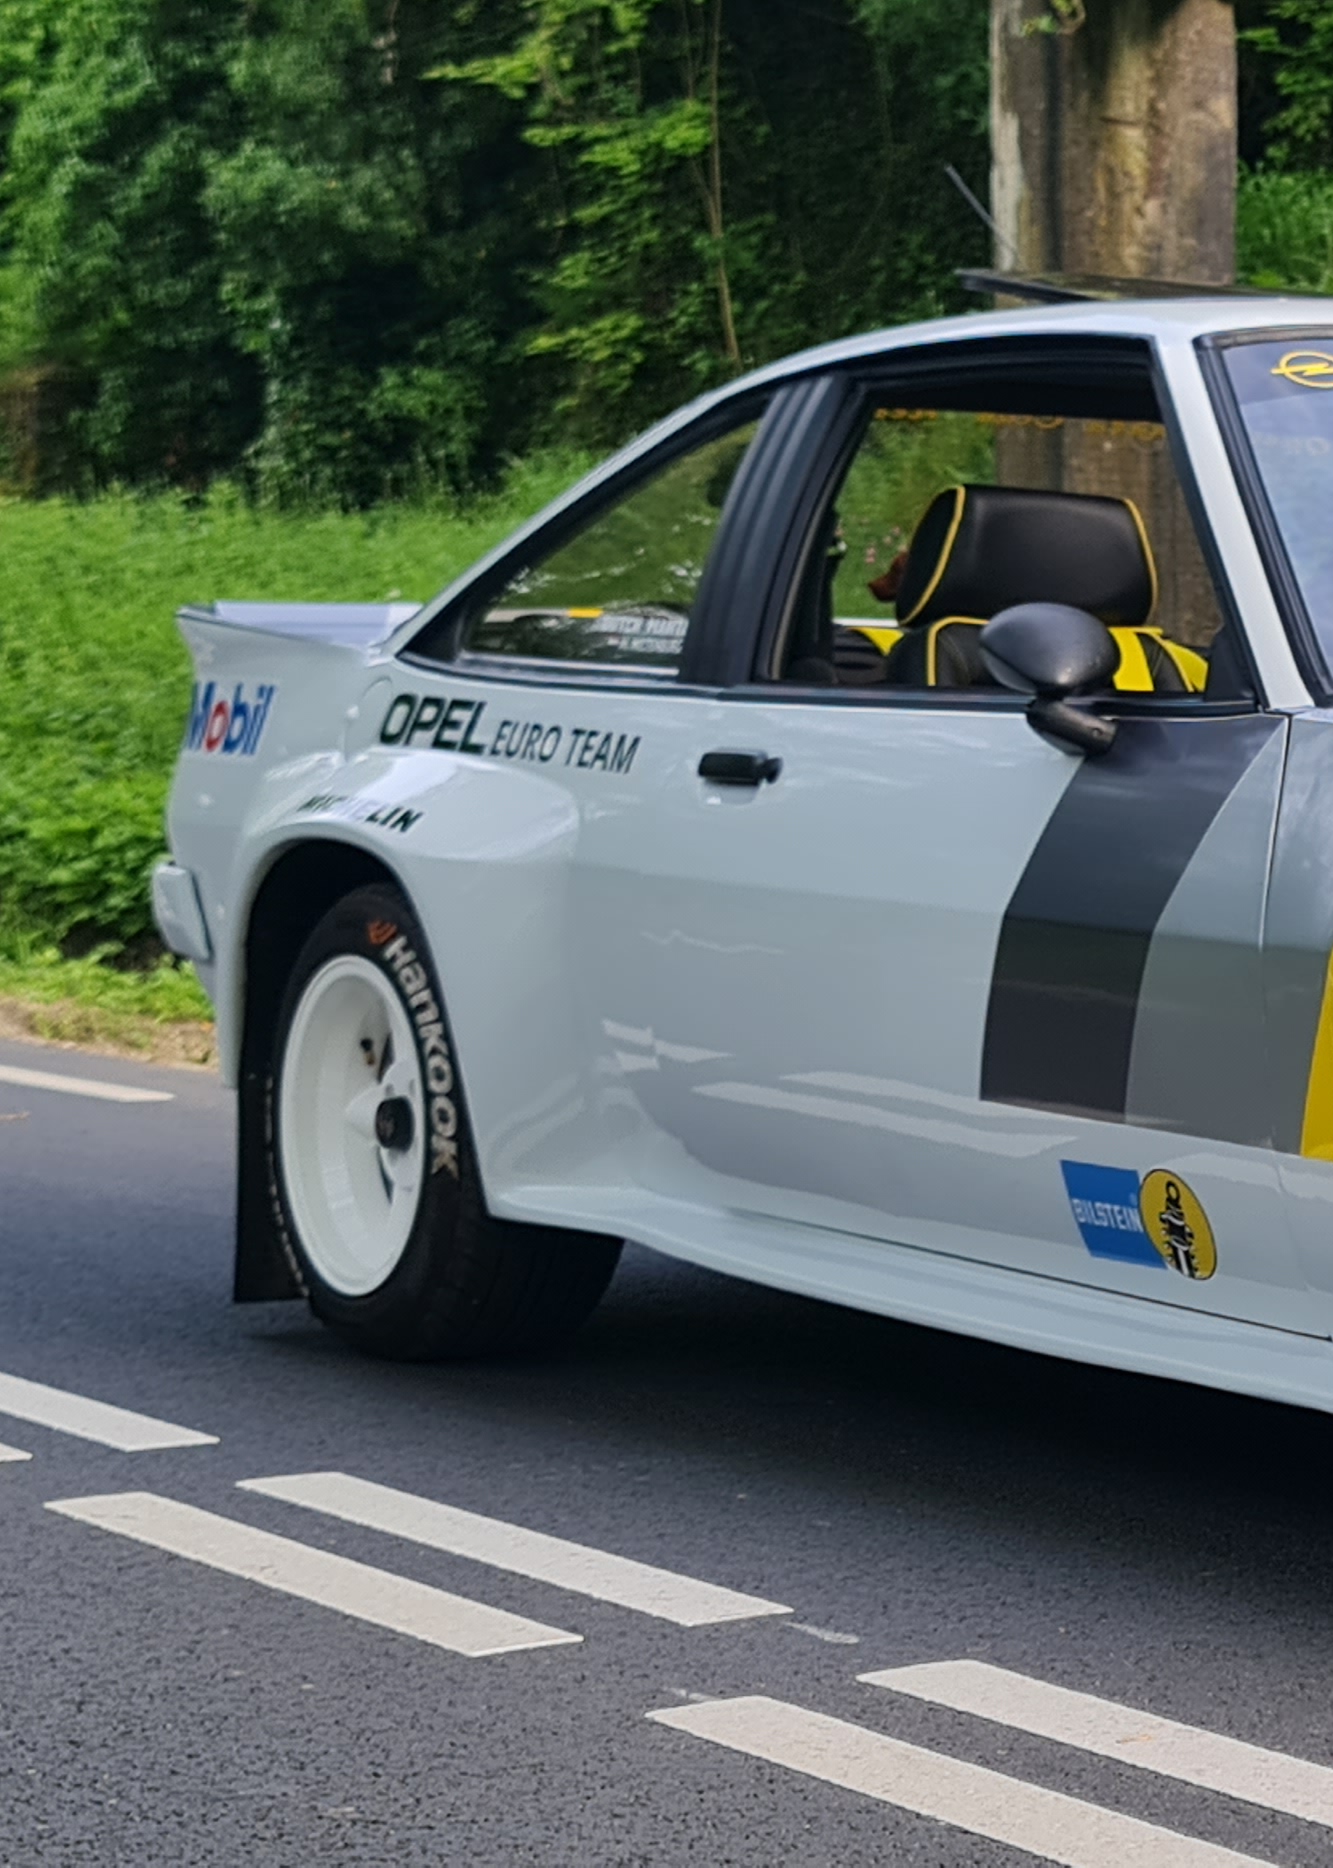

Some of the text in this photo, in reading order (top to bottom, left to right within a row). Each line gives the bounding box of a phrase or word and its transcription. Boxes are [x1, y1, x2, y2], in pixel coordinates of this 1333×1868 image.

[187, 681, 277, 756] Mobil
[379, 693, 642, 775] OPEL EURO TEAM
[1073, 1199, 1144, 1233] BILSTEIN
